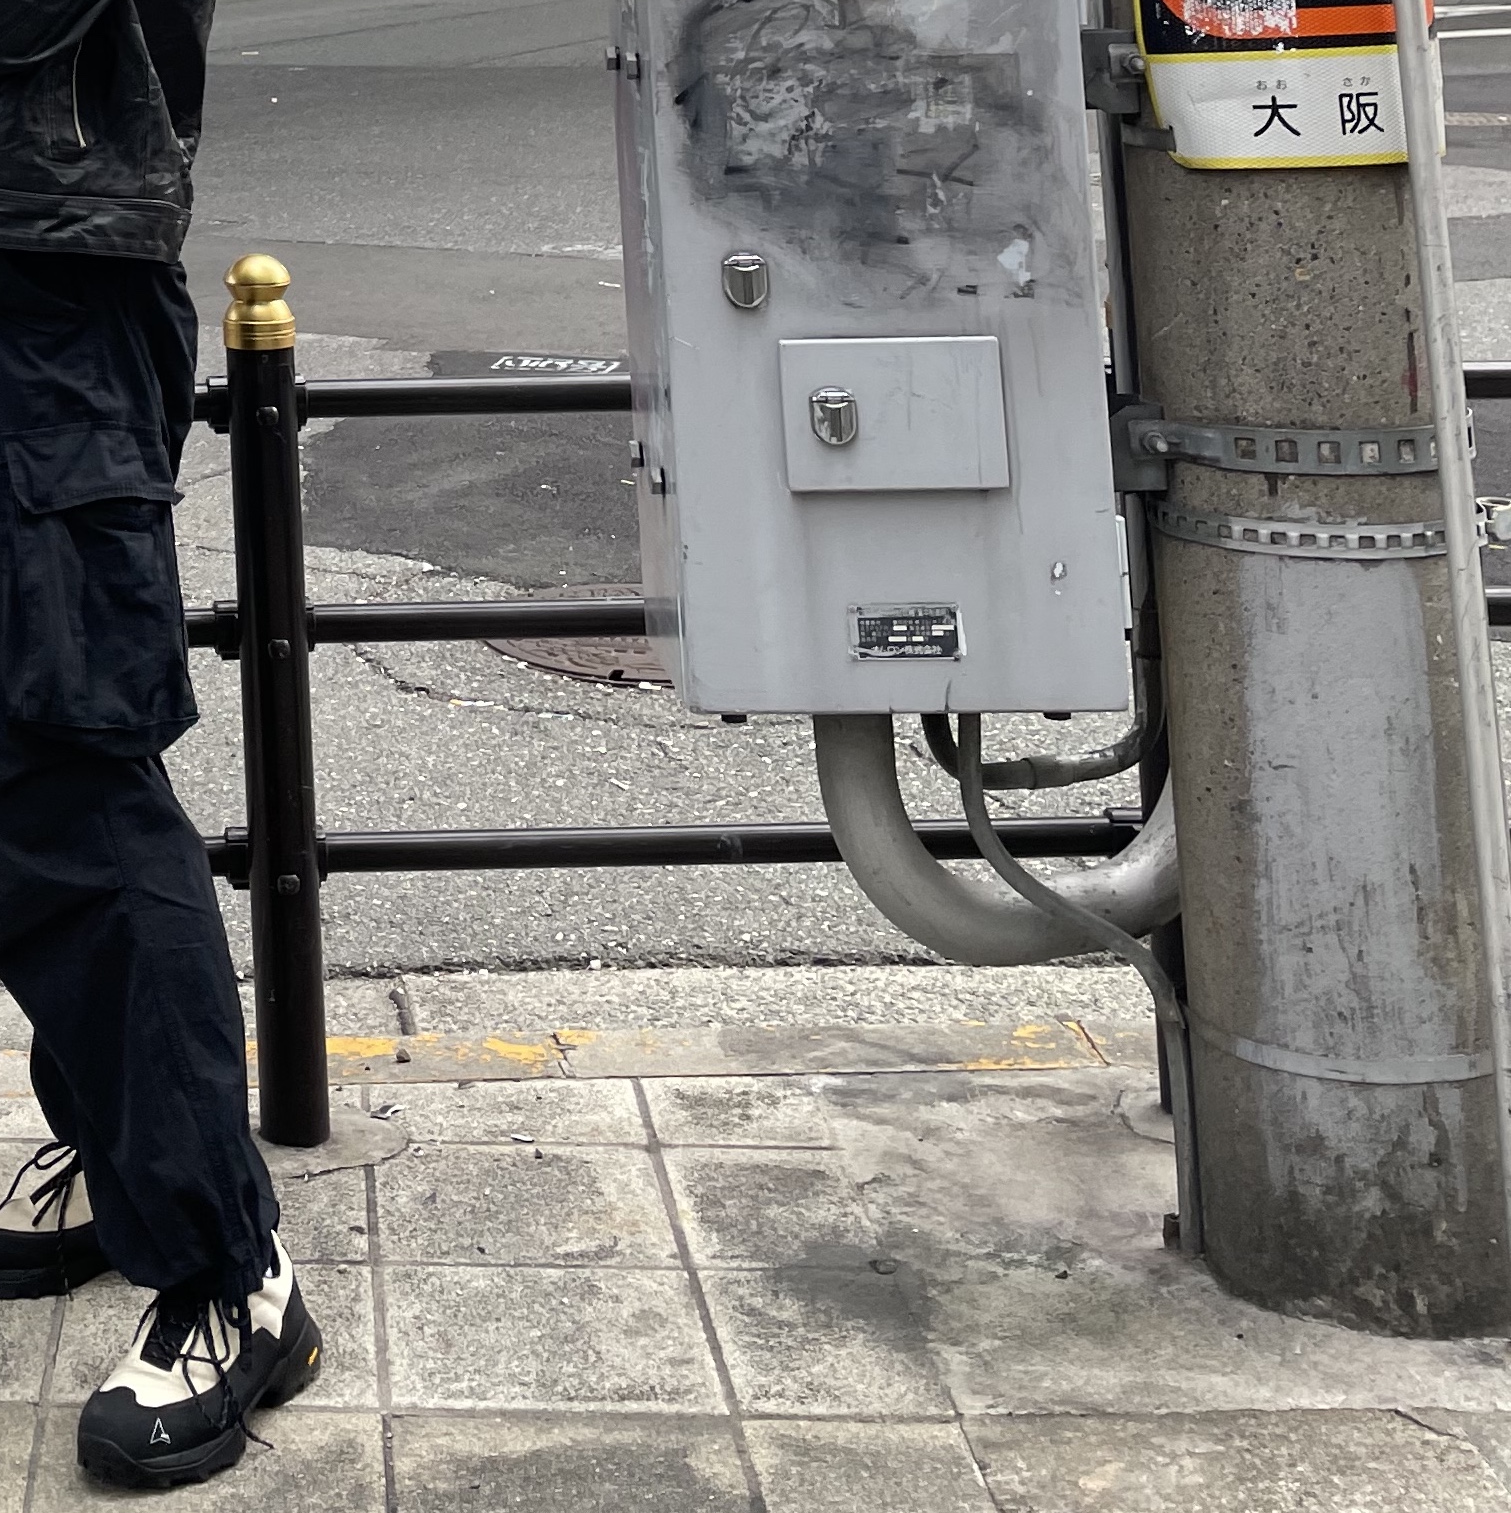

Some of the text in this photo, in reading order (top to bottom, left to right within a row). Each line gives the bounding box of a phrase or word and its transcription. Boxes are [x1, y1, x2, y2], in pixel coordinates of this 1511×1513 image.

[1256, 76, 1371, 90] おお さか
[1252, 91, 1385, 137] 大阪
